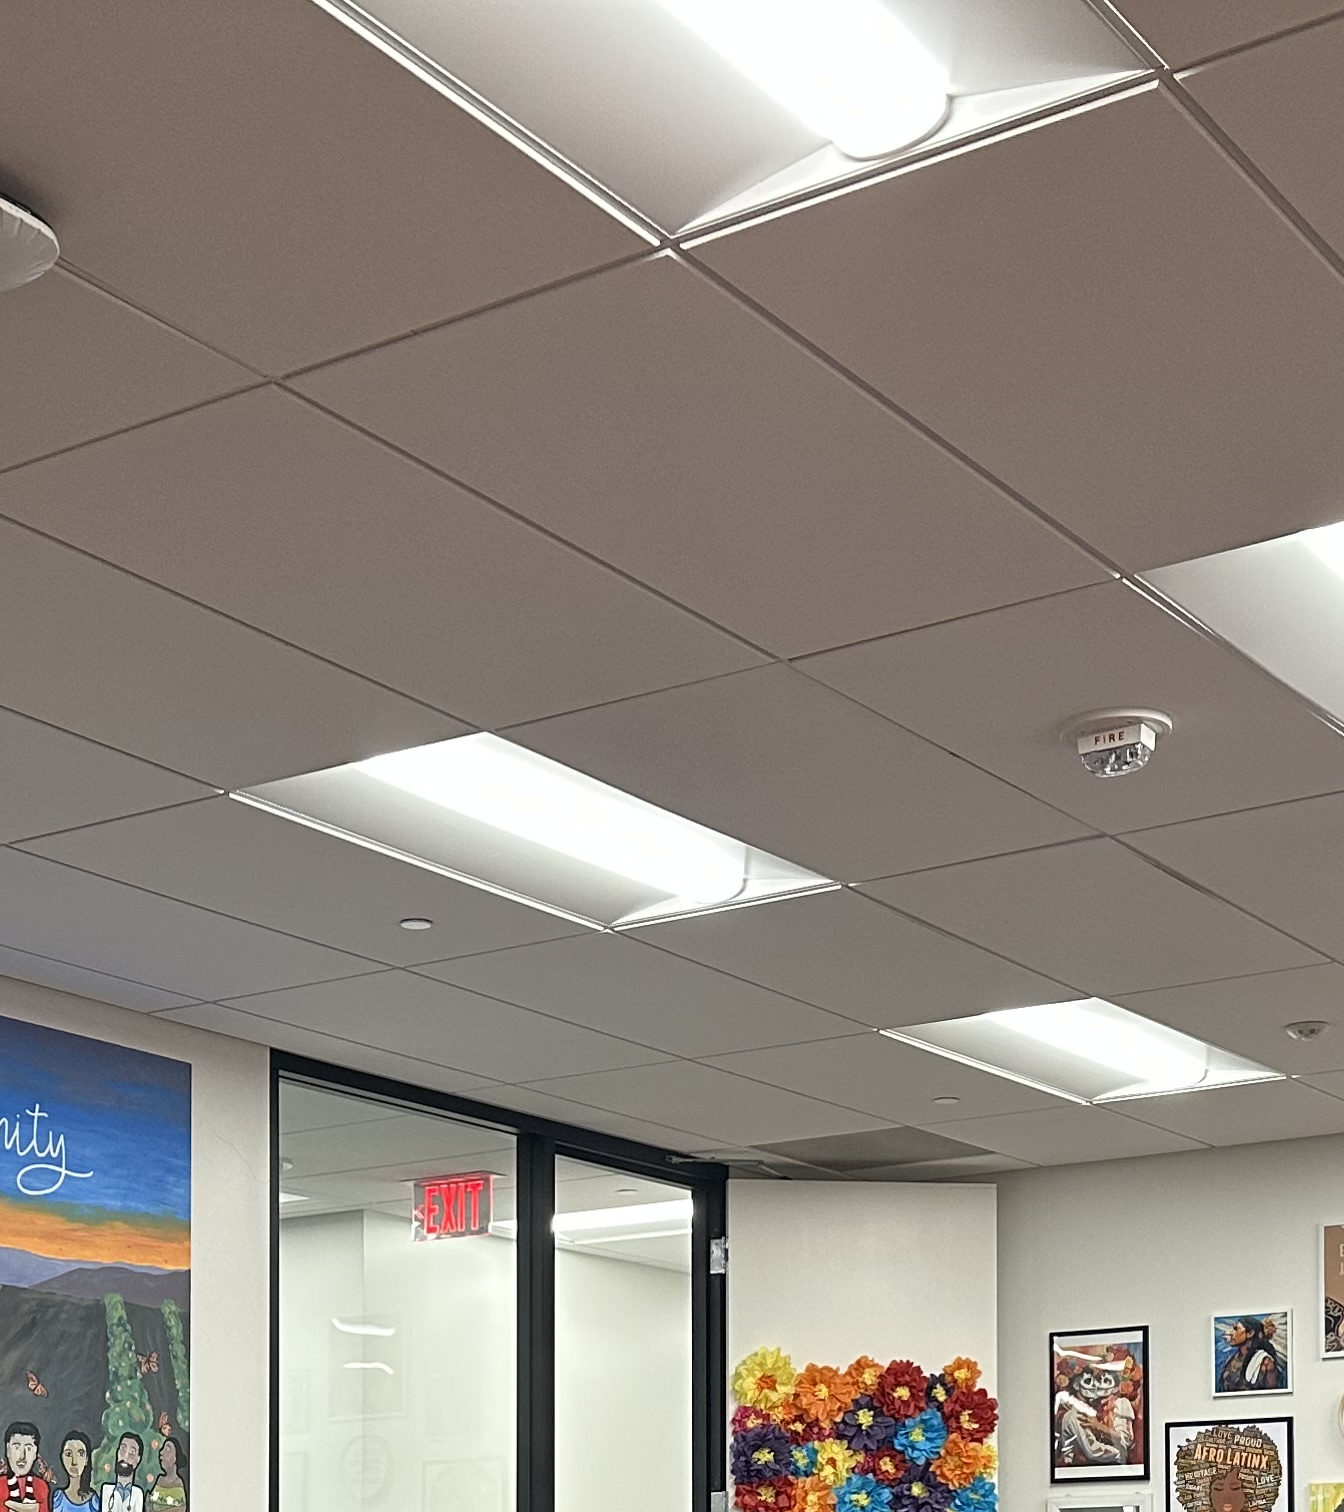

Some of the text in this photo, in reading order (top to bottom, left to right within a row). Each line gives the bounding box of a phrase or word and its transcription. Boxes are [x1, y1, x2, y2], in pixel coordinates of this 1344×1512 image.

[1094, 731, 1125, 745] FIRE
[424, 1181, 484, 1235] EXIT
[1213, 1427, 1262, 1448] LOVE PROUD
[1194, 1443, 1269, 1470] AFRO LATINX
